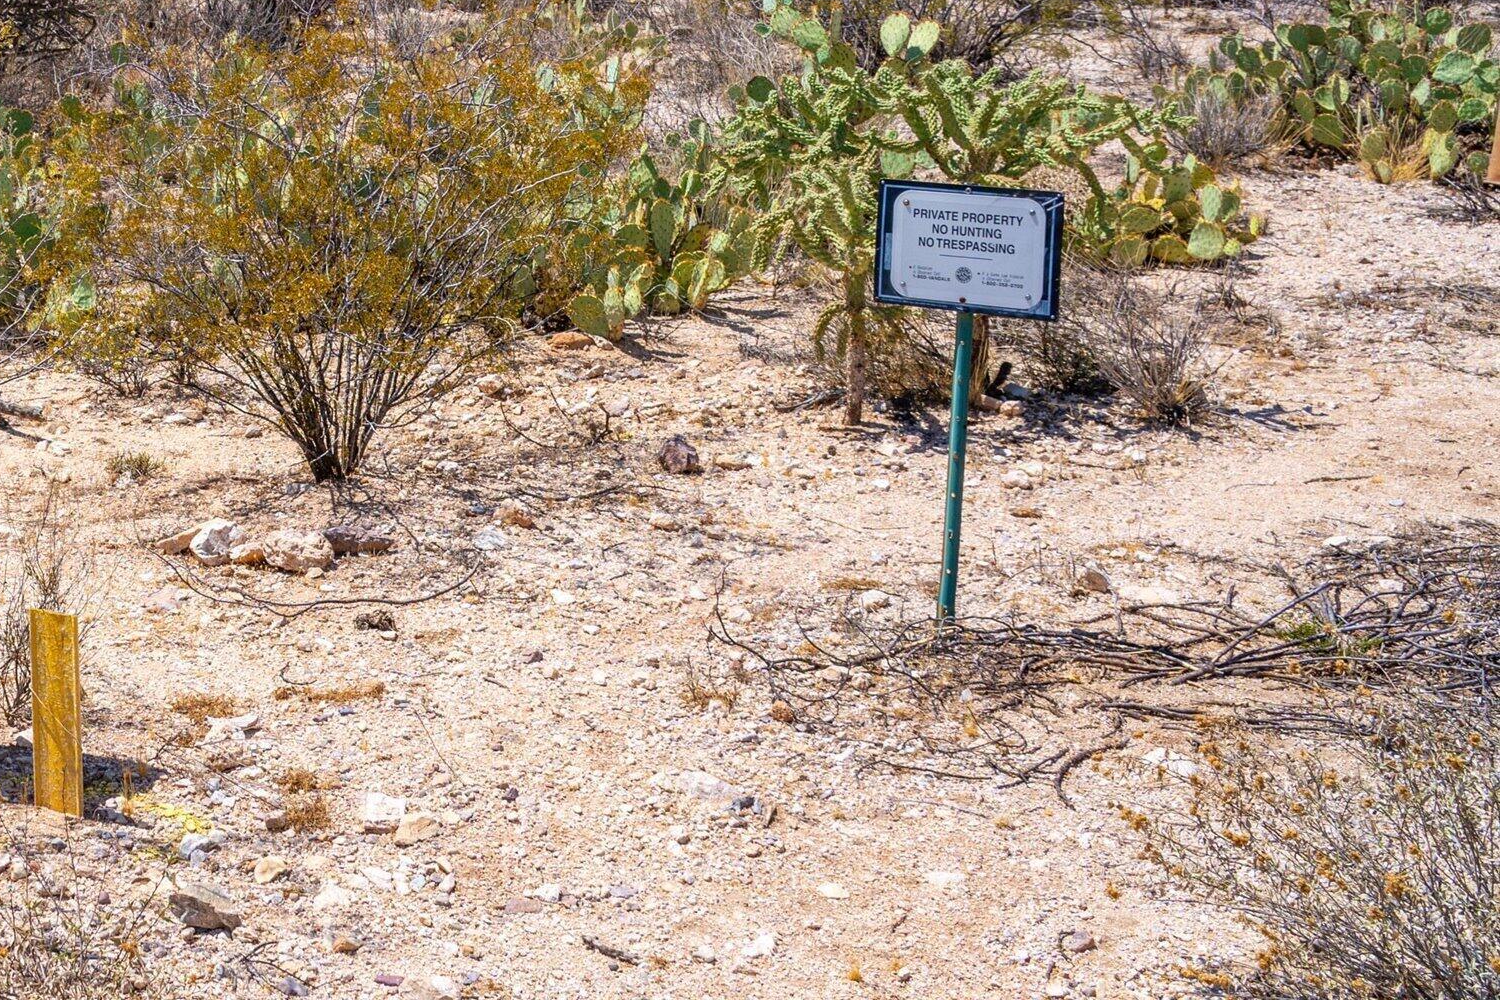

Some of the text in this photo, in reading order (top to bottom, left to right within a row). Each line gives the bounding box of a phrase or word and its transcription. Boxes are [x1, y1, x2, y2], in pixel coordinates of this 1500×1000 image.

[913, 208, 1024, 226] PRIVATE PROPERTY
[932, 224, 1002, 239] NO HUNTING
[918, 237, 1015, 254] NO TRESPASSING
